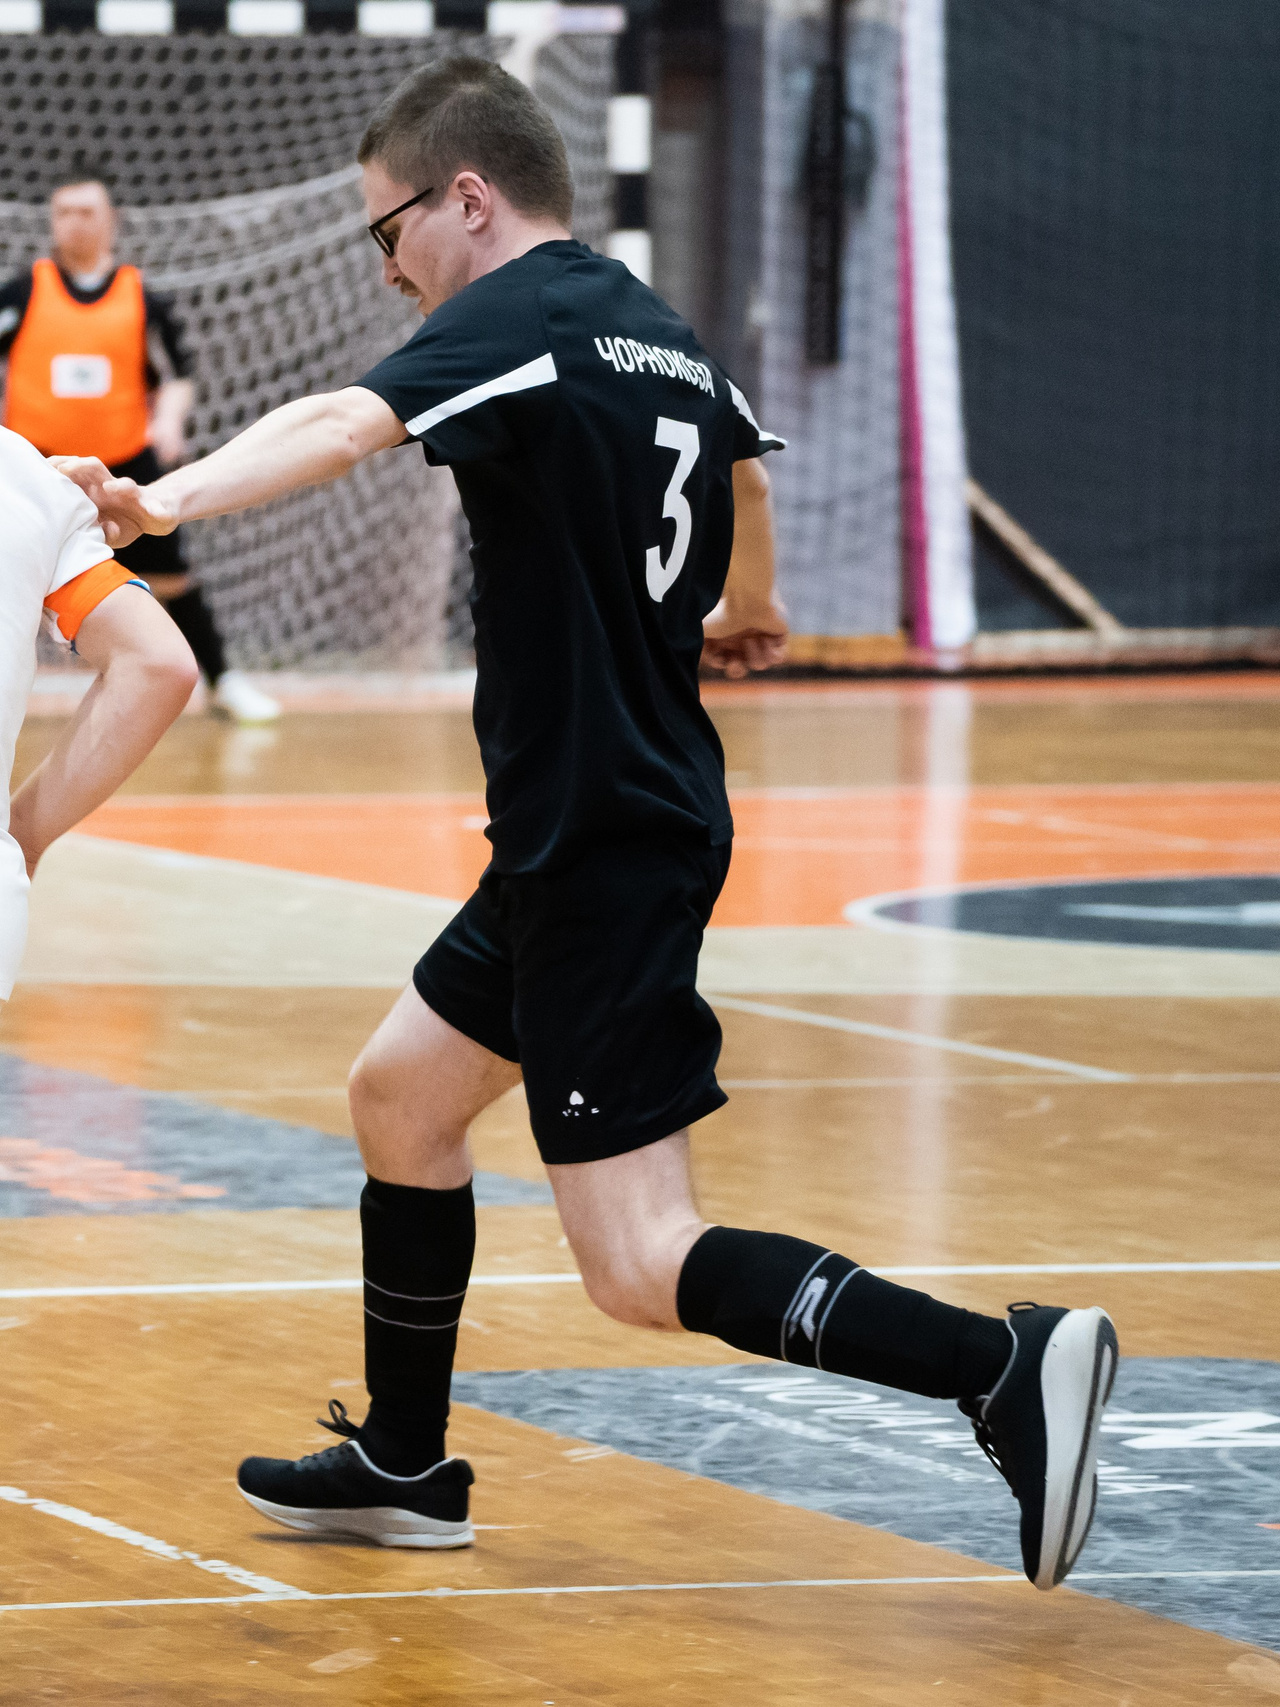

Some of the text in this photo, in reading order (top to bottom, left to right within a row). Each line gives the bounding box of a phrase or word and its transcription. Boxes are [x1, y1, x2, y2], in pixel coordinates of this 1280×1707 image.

[594, 337, 715, 398] ЧОРНОКОЗА
[646, 416, 700, 603] 3
[715, 1377, 954, 1428] NOVA
